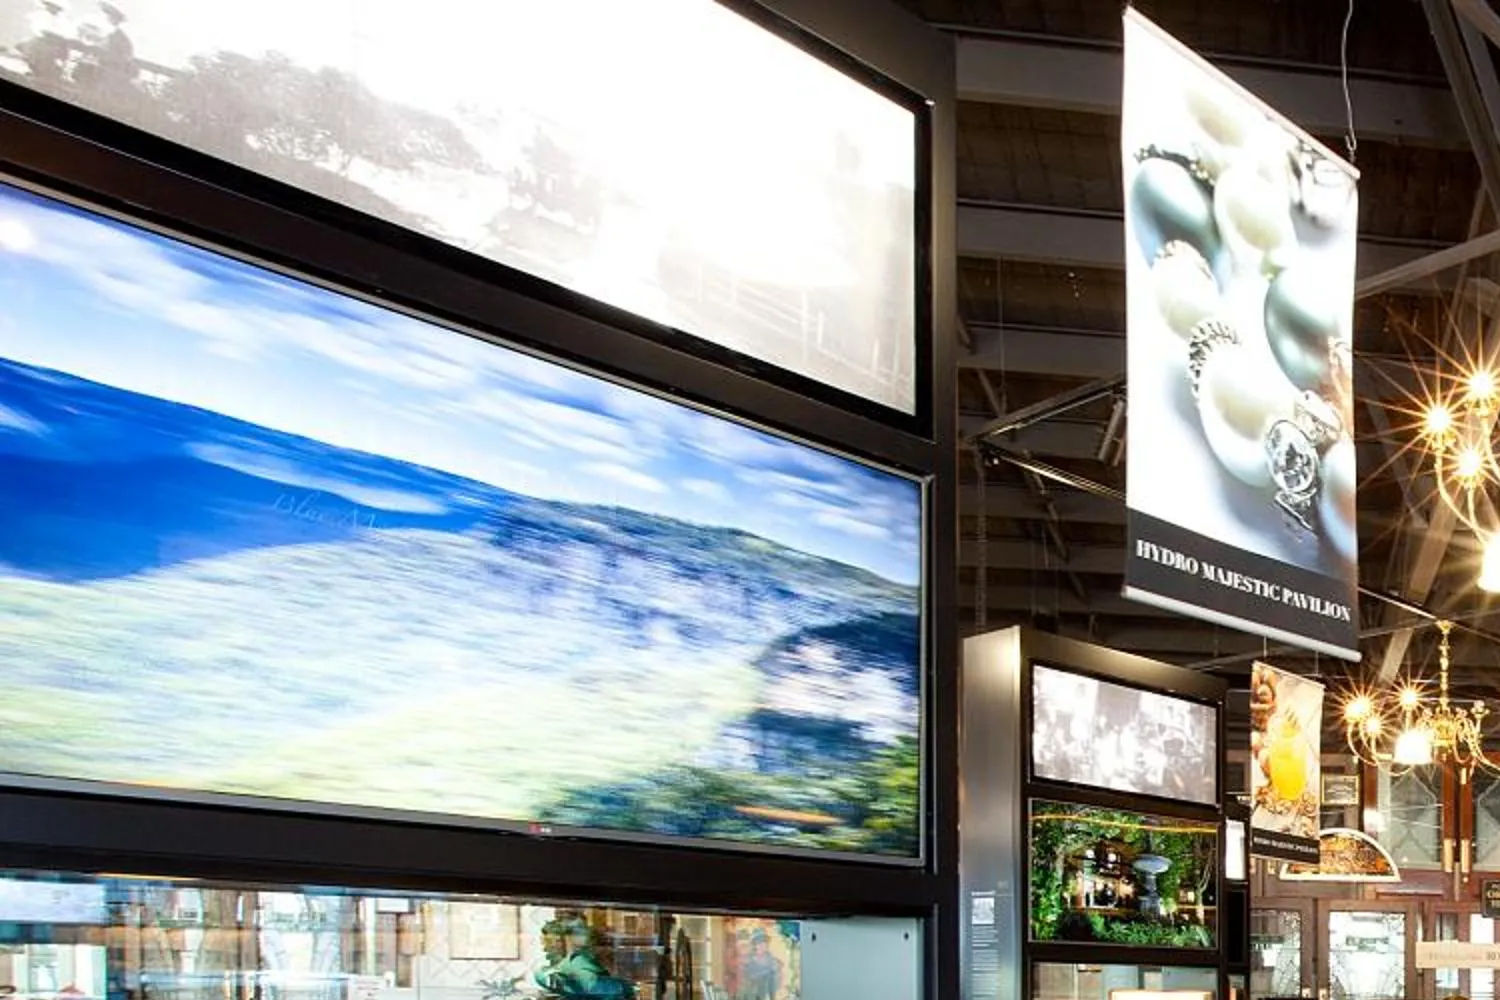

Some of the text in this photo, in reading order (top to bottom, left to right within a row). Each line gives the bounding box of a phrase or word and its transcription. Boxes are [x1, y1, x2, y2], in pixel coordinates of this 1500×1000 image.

[1136, 539, 1351, 622] HYDRO MAJESTIC PAVILION
